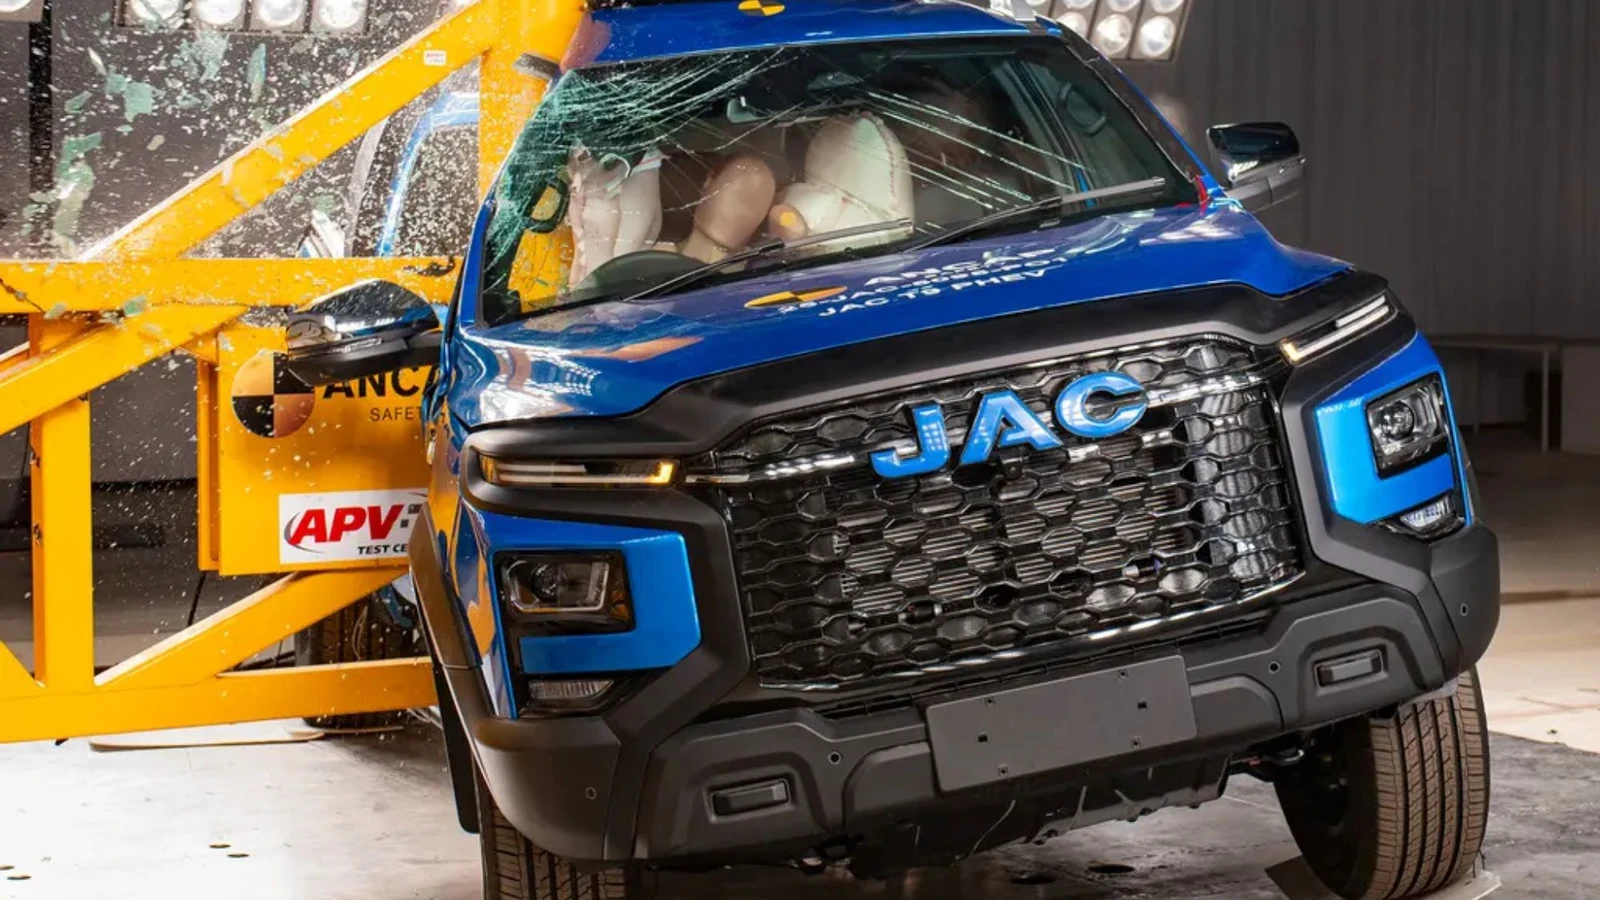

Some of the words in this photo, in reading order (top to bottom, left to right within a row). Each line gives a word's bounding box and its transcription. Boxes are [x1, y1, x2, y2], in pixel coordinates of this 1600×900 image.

[818, 297, 889, 316] JAC
[951, 264, 1063, 291] PHEV
[870, 370, 1149, 479] JAC
[357, 544, 391, 555] TEST
